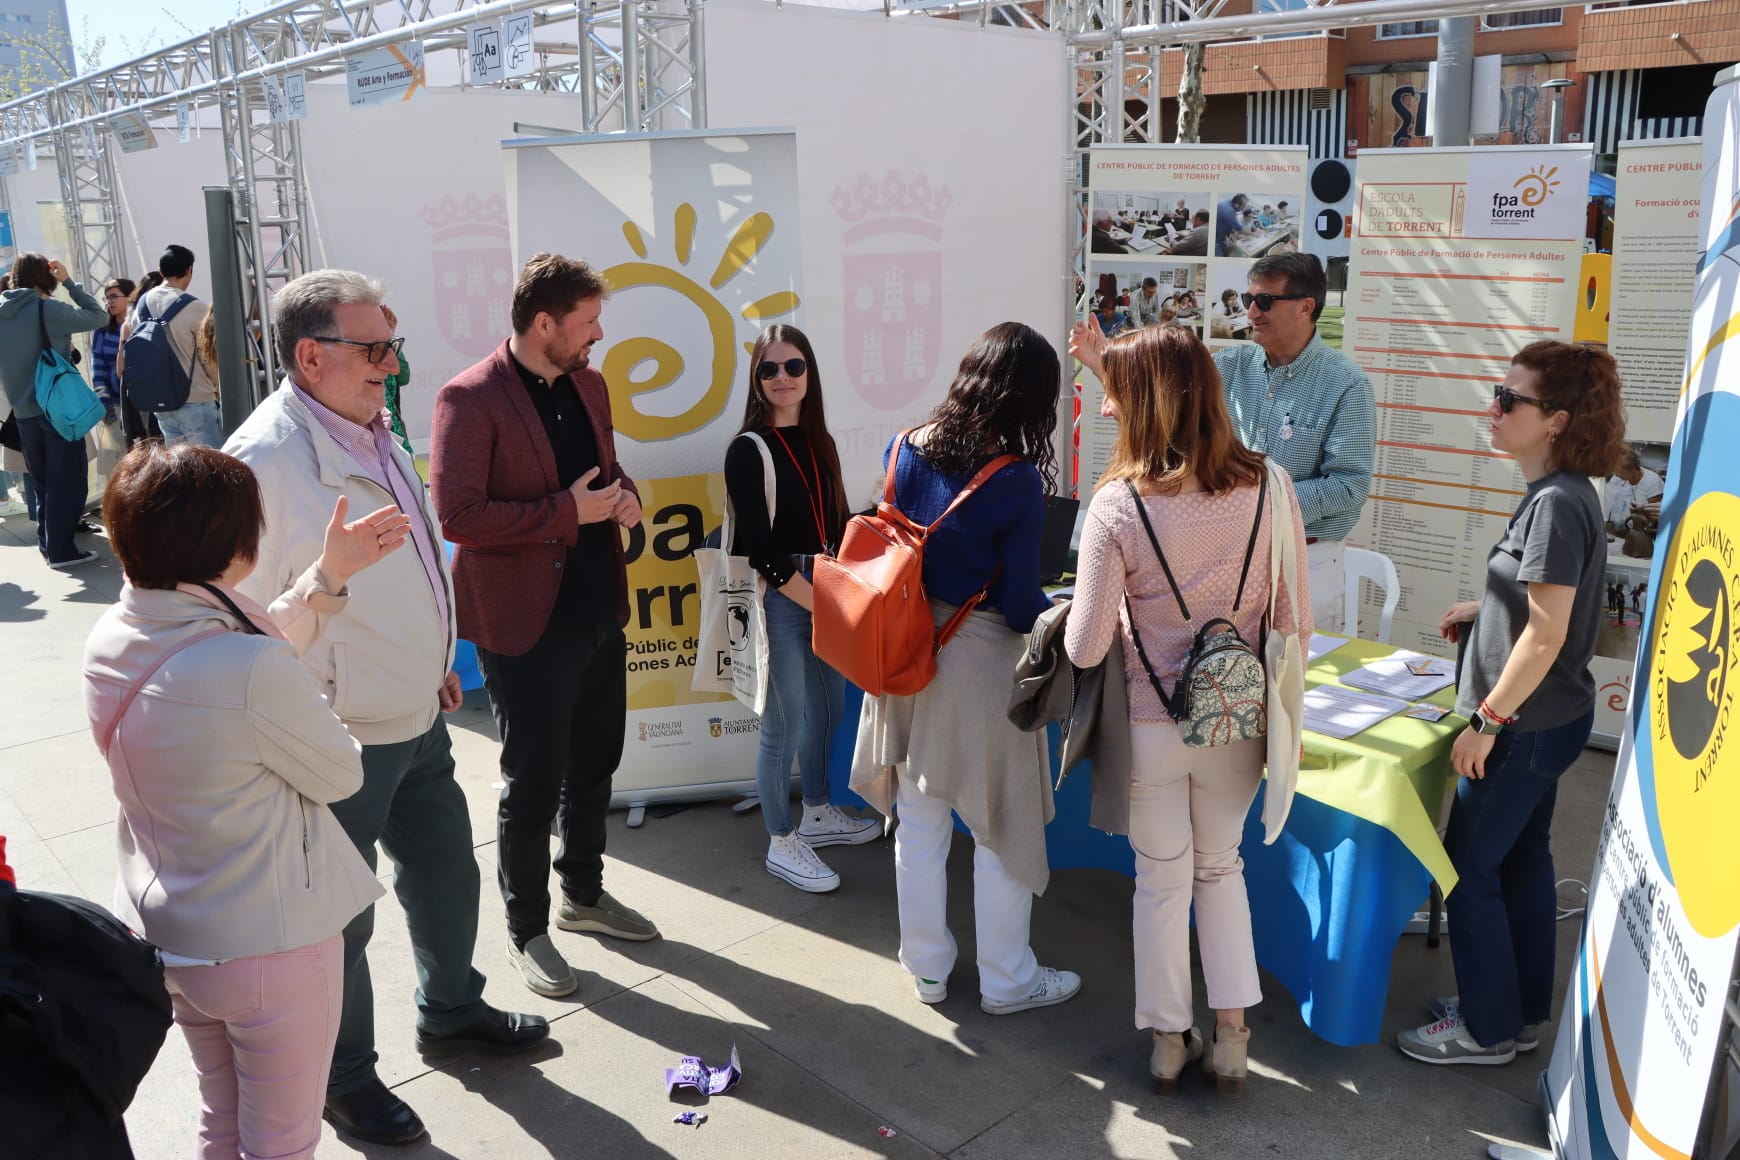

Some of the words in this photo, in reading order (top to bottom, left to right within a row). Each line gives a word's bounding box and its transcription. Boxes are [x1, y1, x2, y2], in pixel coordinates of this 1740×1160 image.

[484, 43, 496, 57] Aa
[372, 75, 382, 84] Arte
[1127, 161, 1154, 170] PÚBLIC
[1168, 162, 1209, 170] FORMACIÓ
[1223, 163, 1264, 171] PERSONES
[1265, 164, 1301, 172] ADULTES
[1626, 163, 1665, 174] CENTRE
[1173, 172, 1185, 180] DE
[1185, 172, 1220, 180] TORRENT
[1370, 192, 1416, 203] ESCOLA
[1493, 193, 1518, 209] fpa
[1635, 198, 1681, 208] Formació
[1492, 208, 1535, 218] torrent
[1368, 221, 1384, 232] DE
[1386, 221, 1444, 232] TORRENT
[1360, 247, 1389, 256] Centre
[1390, 247, 1417, 257] Públic
[1417, 248, 1430, 257] de
[1430, 248, 1471, 258] Formació
[1473, 250, 1484, 259] de
[1486, 250, 1527, 260] Persones
[1529, 251, 1566, 261] Adultes
[724, 717, 760, 727] AJUNTAMEN
[1694, 692, 1735, 793] TORRENT
[1608, 791, 1648, 888] Associació
[1648, 880, 1707, 1008] d'alumnes
[1628, 884, 1650, 934] públic
[1651, 930, 1661, 957] de
[1660, 949, 1699, 1037] formació
[1626, 916, 1651, 975] adultes
[1651, 970, 1661, 997] de
[1661, 988, 1692, 1067] Torrent
